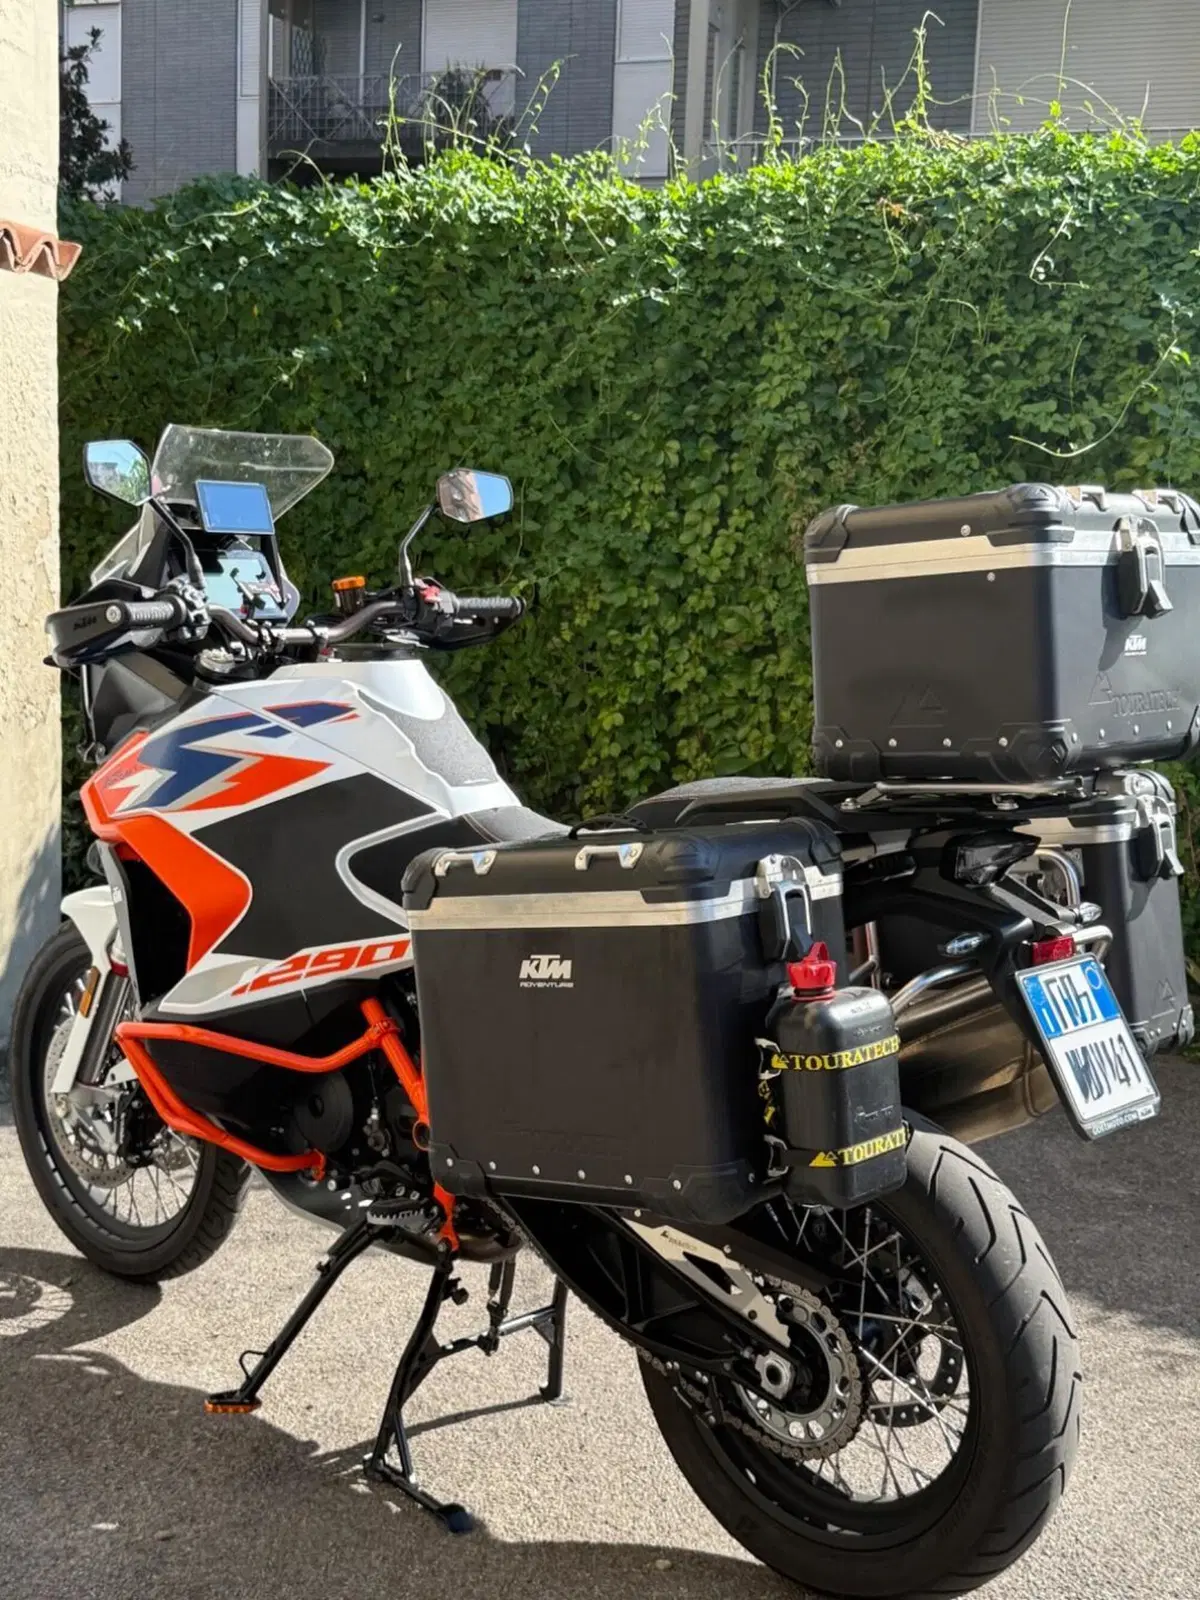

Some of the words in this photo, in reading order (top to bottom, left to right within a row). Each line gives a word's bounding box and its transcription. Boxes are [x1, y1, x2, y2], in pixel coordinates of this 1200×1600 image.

[1124, 634, 1147, 651] KTM
[519, 954, 572, 979] KTM
[790, 1034, 901, 1071] TOURATECH
